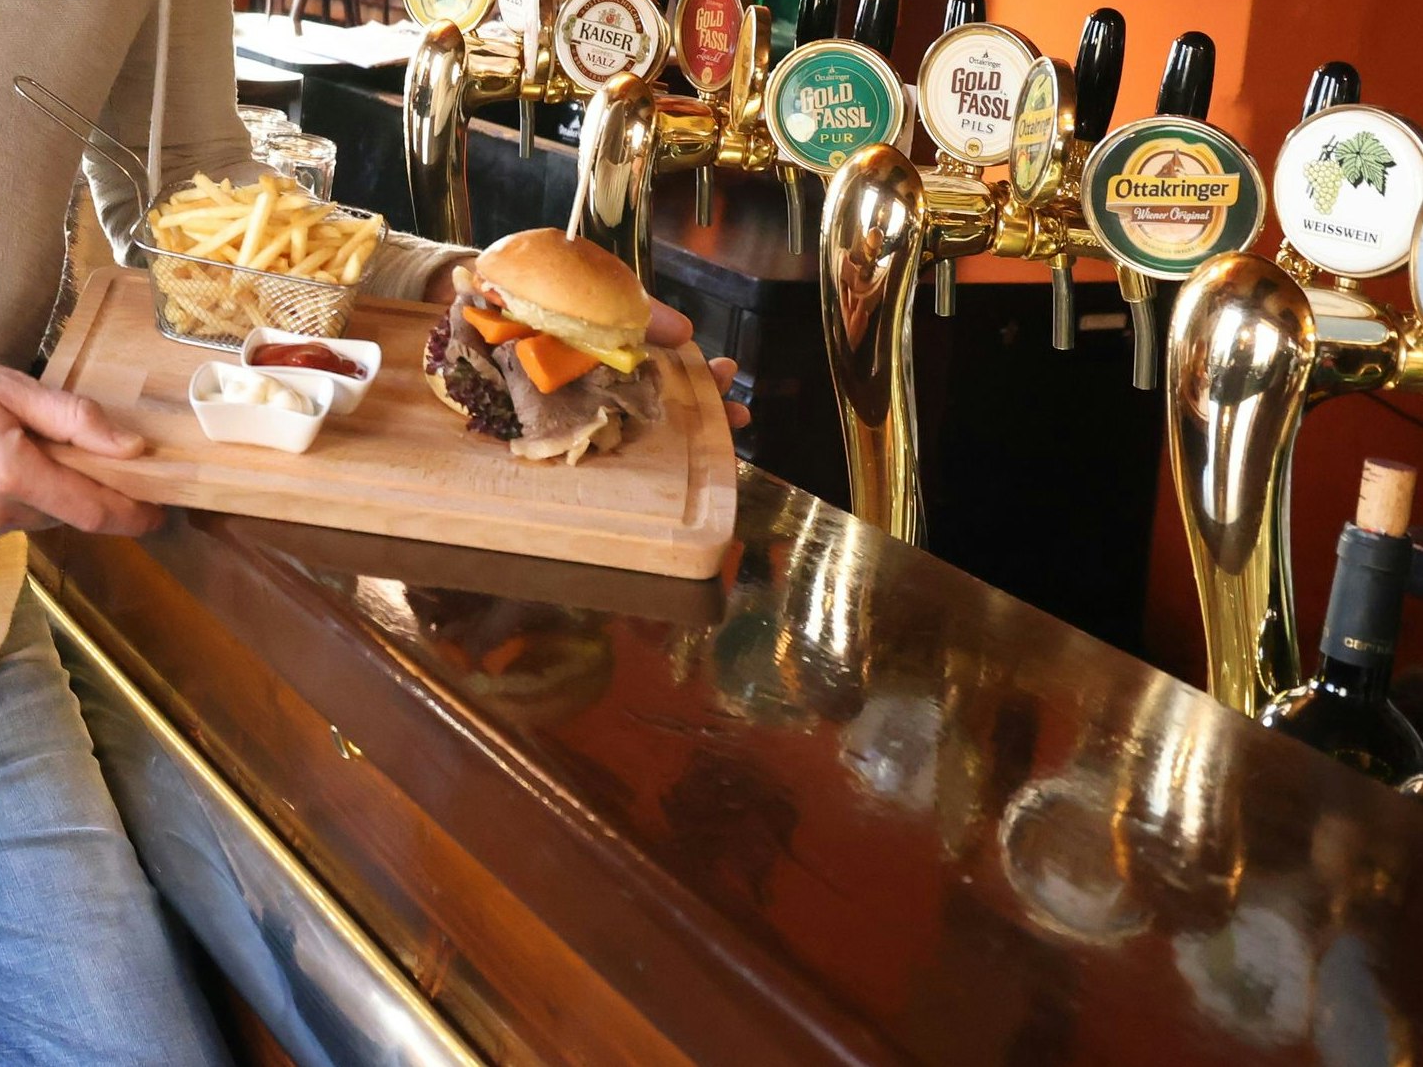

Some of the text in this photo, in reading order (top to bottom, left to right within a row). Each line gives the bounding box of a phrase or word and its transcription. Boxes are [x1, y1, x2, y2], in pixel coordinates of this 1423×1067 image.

[696, 7, 724, 31] GOLD
[579, 22, 633, 51] KAISER
[699, 28, 729, 52] FASSL
[586, 53, 616, 68] MALZ
[951, 67, 1001, 94] GOLD
[800, 82, 853, 114] GOLD
[958, 91, 1012, 121] FASSL
[812, 106, 872, 131] FASSL
[961, 118, 995, 134] PILS
[820, 133, 853, 144] PUR
[1115, 179, 1229, 202] Ottakringer
[1133, 206, 1210, 224] Wiener Original
[1303, 218, 1378, 244] WEISSWEIN
